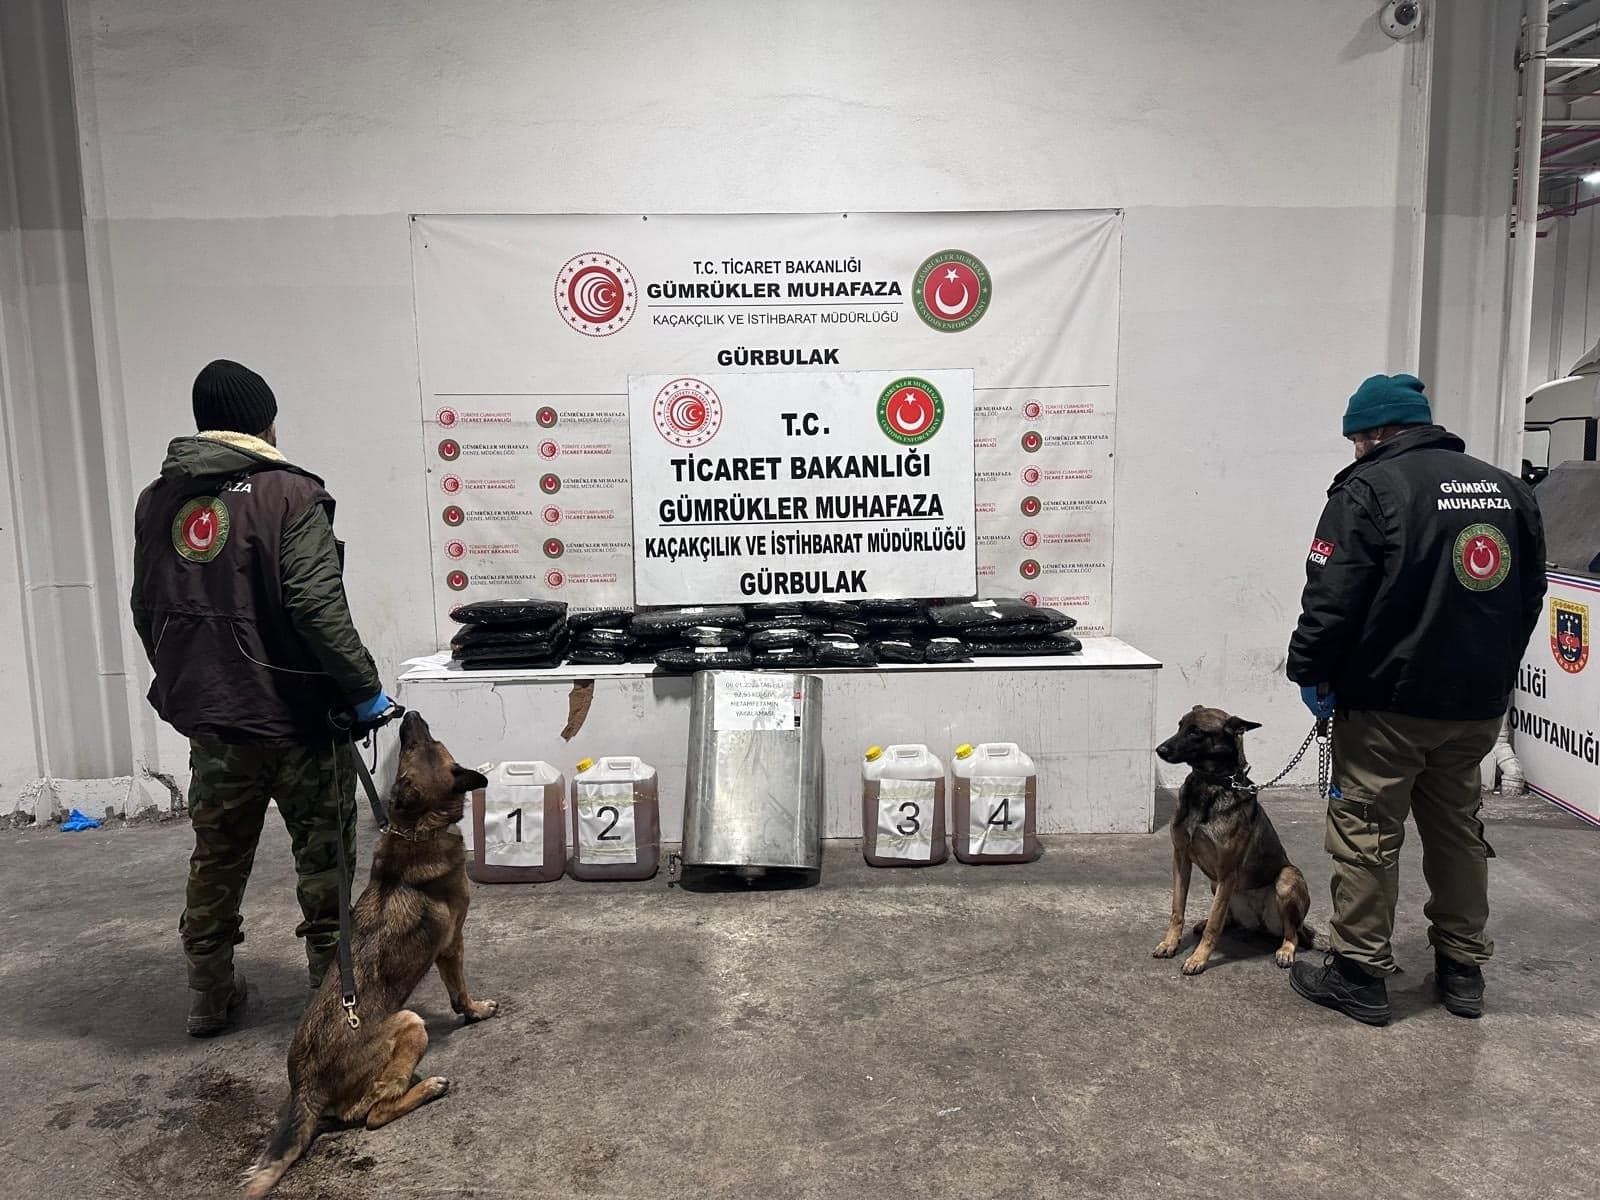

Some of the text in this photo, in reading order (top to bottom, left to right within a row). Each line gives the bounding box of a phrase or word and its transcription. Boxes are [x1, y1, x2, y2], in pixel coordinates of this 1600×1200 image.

[693, 256, 861, 275] T.C. TİCARET BAKANLIĞI
[646, 280, 902, 299] GÜMRÜKLER MUHAFAZA
[653, 309, 899, 328] KAÇAKÇILIK VE İSTİHBARAT MÜDÜRLÜĞÜ
[717, 346, 841, 367] GÜRBULAK
[781, 412, 830, 436] T.C.
[670, 447, 930, 482] TİCARET BAKANLIĞI
[1439, 479, 1502, 494] GÜMRÜK
[659, 493, 944, 522] GÜMRÜKLER MUHAFAZA
[1437, 497, 1512, 511] MUHAFAZA
[645, 526, 966, 562] KAÇAKÇILIK VE İSTİHBARAT MÜDÜRLÜĞÜ
[1308, 550, 1328, 567] KEM
[740, 567, 868, 595] GÜRBULAK
[1509, 706, 1599, 766] OMUTANLIĞI
[507, 807, 522, 843] 1
[596, 806, 621, 841] 2
[896, 801, 920, 836] 3
[987, 798, 1013, 832] 4
